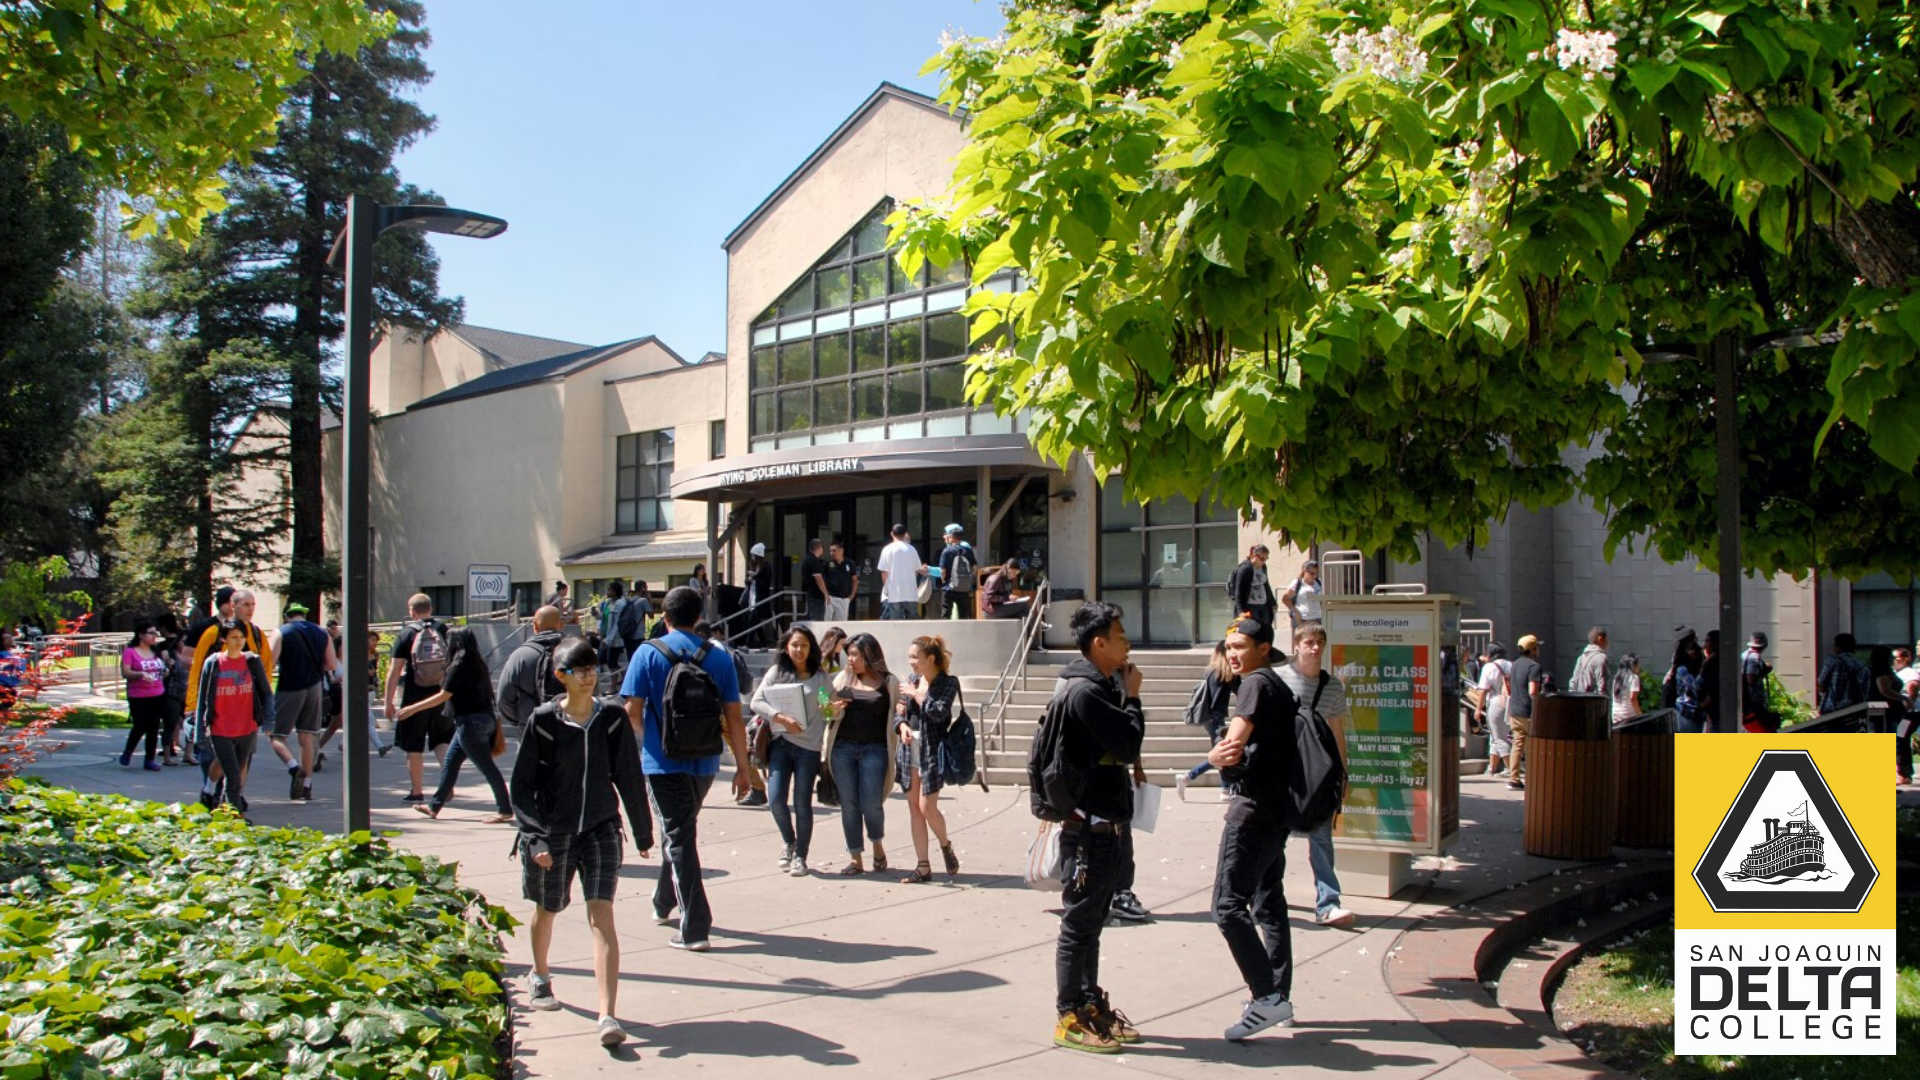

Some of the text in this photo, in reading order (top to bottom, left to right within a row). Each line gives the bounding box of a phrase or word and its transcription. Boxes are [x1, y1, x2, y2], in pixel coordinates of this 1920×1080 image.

[719, 470, 745, 486] RVING
[809, 458, 859, 473] LIBRARY
[1353, 618, 1409, 628] thecollegian
[1333, 665, 1427, 678] NEED A CLASS
[216, 682, 253, 696] STAR TRE
[1350, 681, 1409, 694] TRANSFER
[1414, 684, 1427, 693] TO
[1356, 698, 1427, 709] STANISLAUS?
[1360, 735, 1380, 743] SUMMER
[1357, 744, 1401, 753] MANY ONLINE
[1366, 773, 1383, 784] April
[1384, 775, 1394, 784] 13
[1415, 776, 1426, 786] 27
